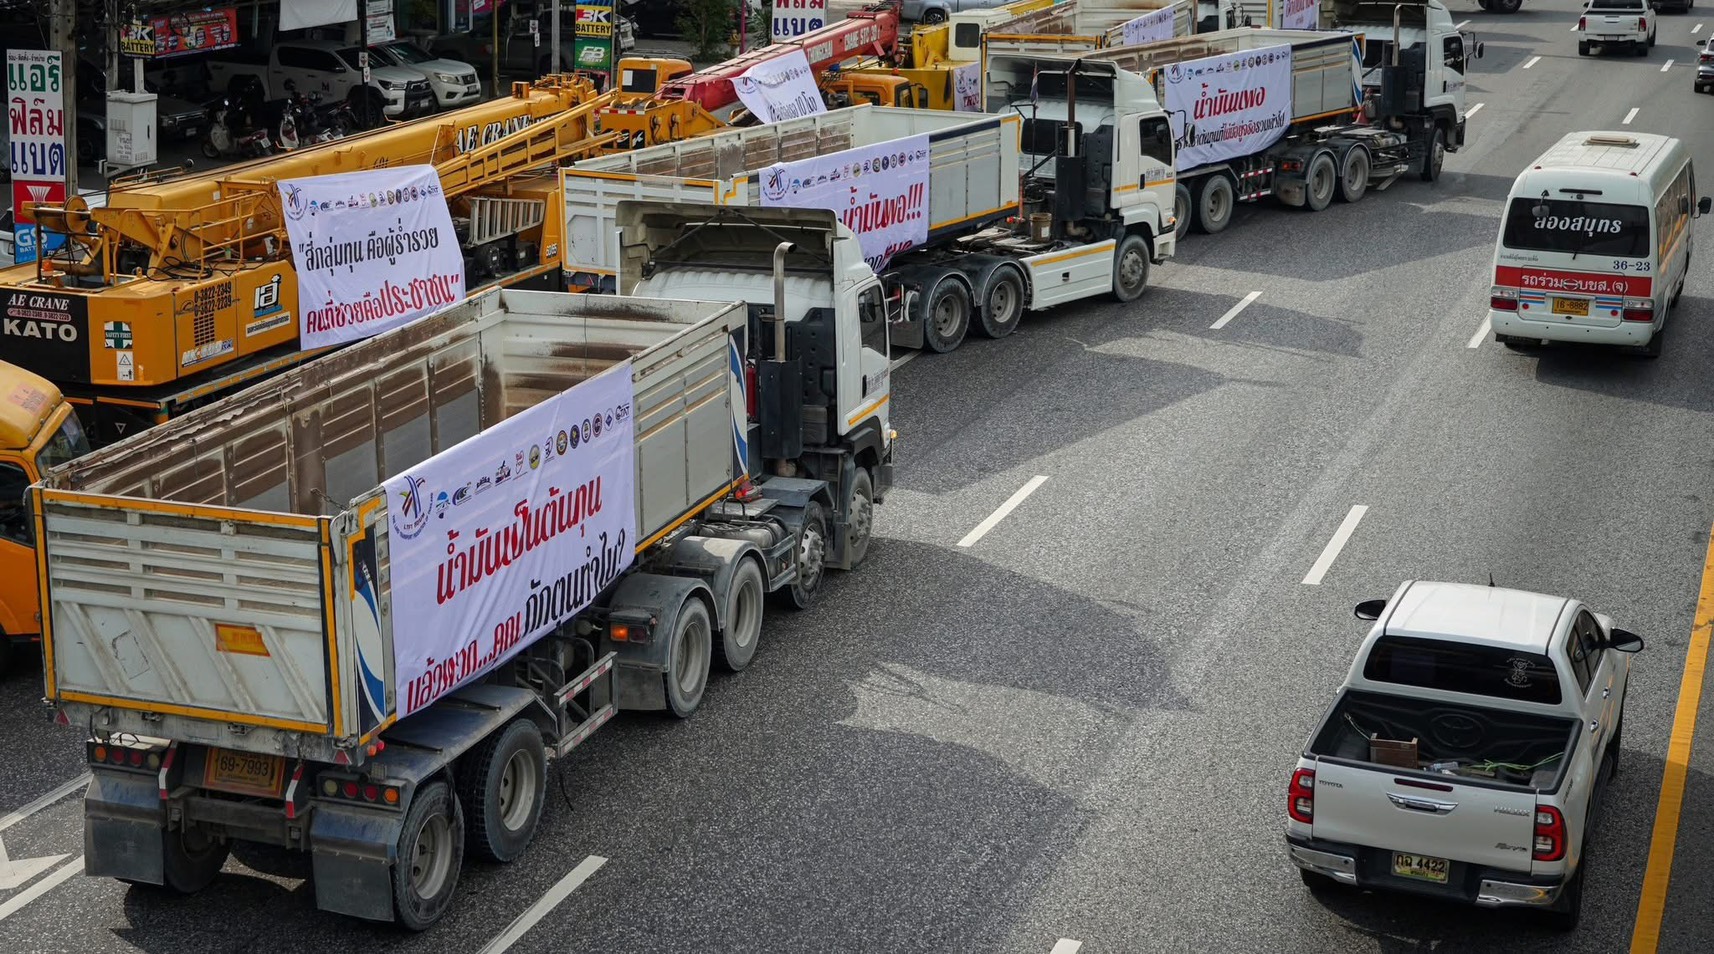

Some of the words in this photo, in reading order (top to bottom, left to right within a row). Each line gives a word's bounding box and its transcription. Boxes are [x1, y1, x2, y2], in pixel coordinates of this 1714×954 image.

[576, 9, 610, 23] 3K
[576, 23, 611, 34] BATTERY
[774, 17, 823, 36] แบต
[121, 41, 154, 53] BATTERY
[8, 55, 60, 92] แอร์
[9, 96, 63, 136] ฟิล์ม
[456, 125, 479, 154] AE
[10, 141, 64, 176] แบต
[838, 182, 924, 234] น้ำมันพอ!!!
[15, 228, 47, 248] GS
[367, 217, 439, 265] คือผู้ร่ำรวย
[1613, 260, 1650, 271] 36-23
[1522, 272, 1564, 287] รถร่วม
[8, 293, 26, 307] AE
[29, 296, 69, 311] CRANE
[3, 318, 77, 342] KATO
[436, 475, 603, 605] น้ำมันเป็นต้นทุน
[219, 756, 269, 776] 69-7993
[1318, 779, 1344, 789] TOYOTA
[1416, 857, 1445, 873] 4422
